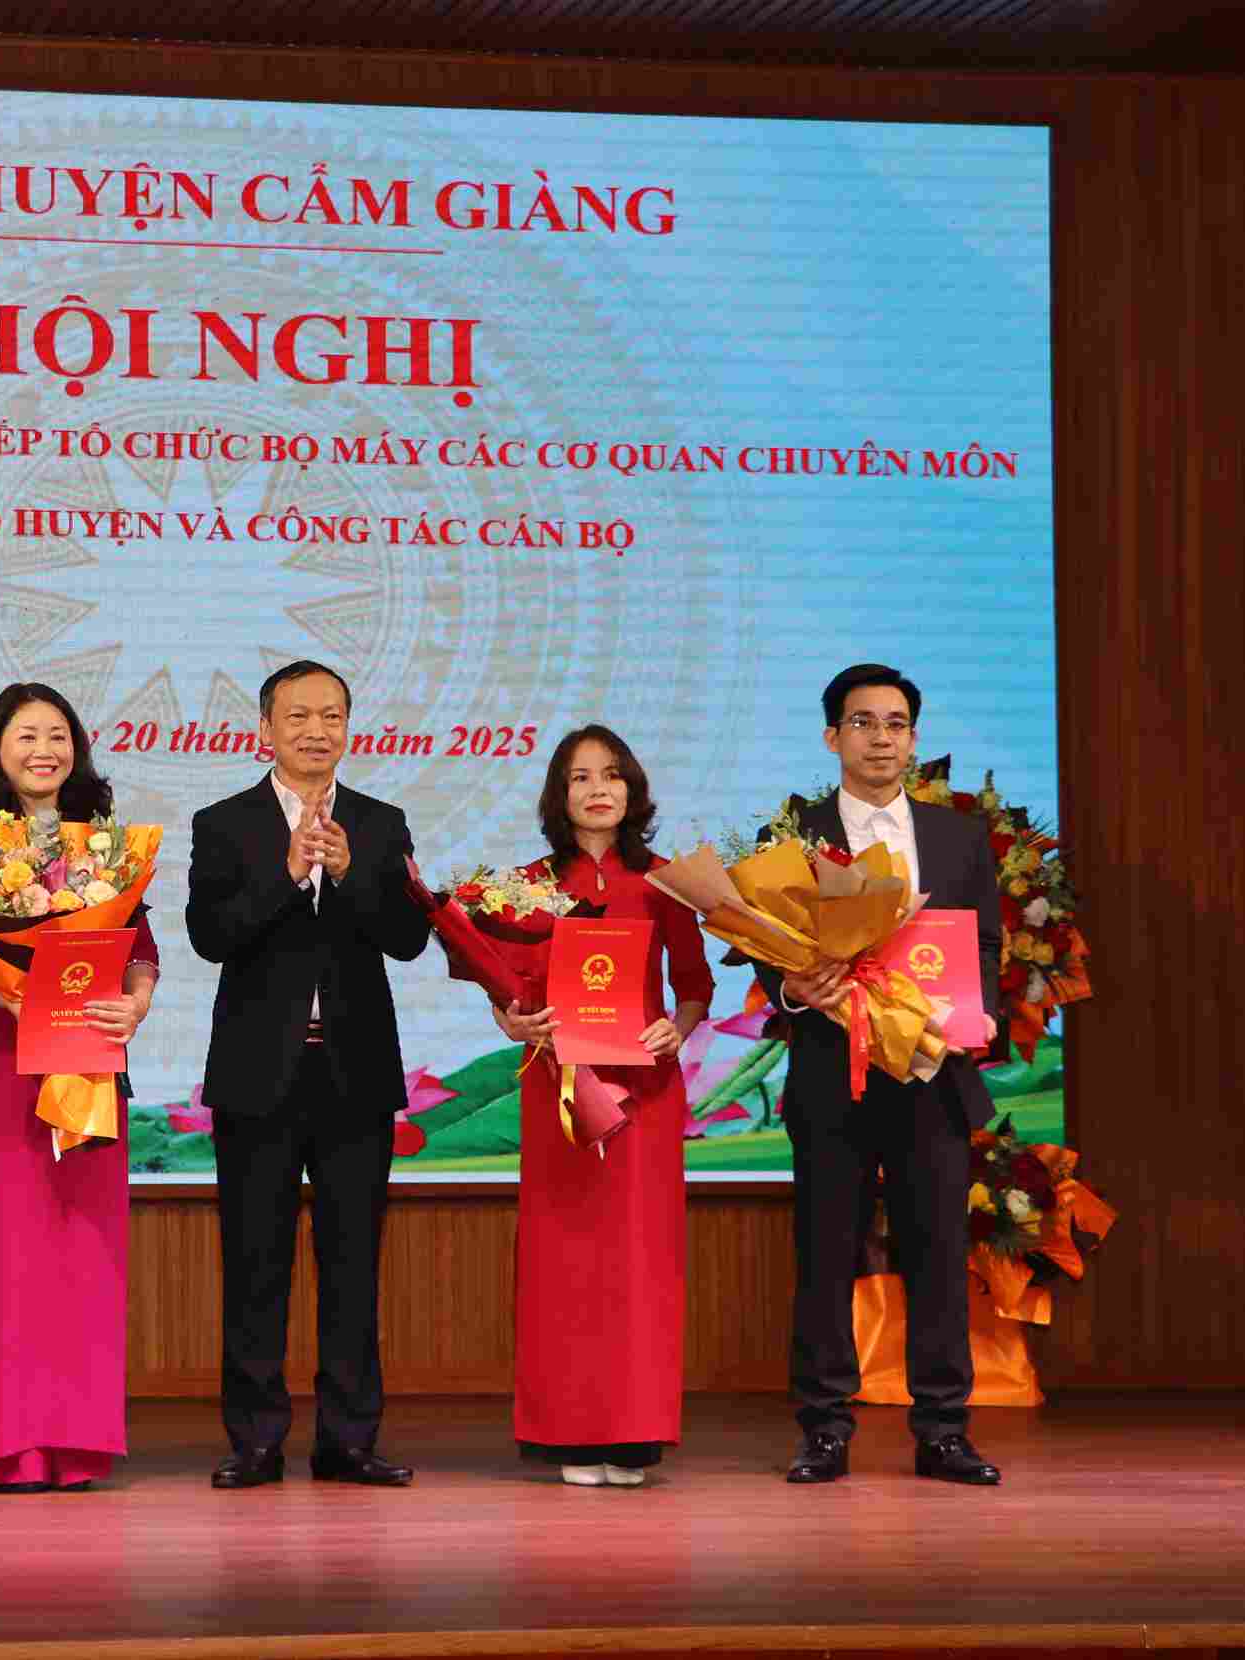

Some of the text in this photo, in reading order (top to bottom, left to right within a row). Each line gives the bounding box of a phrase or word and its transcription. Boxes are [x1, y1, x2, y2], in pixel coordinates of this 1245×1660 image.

[435, 169, 678, 236] GIÀNG
[193, 310, 482, 408] NGHỊ
[122, 425, 250, 462] CHỨC
[261, 432, 320, 470] BỘ
[331, 431, 429, 467] MÁY
[438, 432, 525, 469] CÁC
[537, 441, 597, 470] CƠ
[609, 444, 725, 476] QUAN
[738, 440, 910, 477] CHUYÊN
[922, 441, 1018, 477] MÔN
[14, 507, 164, 546] HUYỆN
[178, 506, 235, 541] VÀ
[246, 505, 371, 545] CÔNG
[381, 512, 467, 548] TÁC
[477, 514, 565, 549] CÁN
[578, 518, 635, 557] BỘ
[109, 720, 159, 753] 20
[350, 723, 434, 756] năm
[445, 725, 538, 758] 2025
